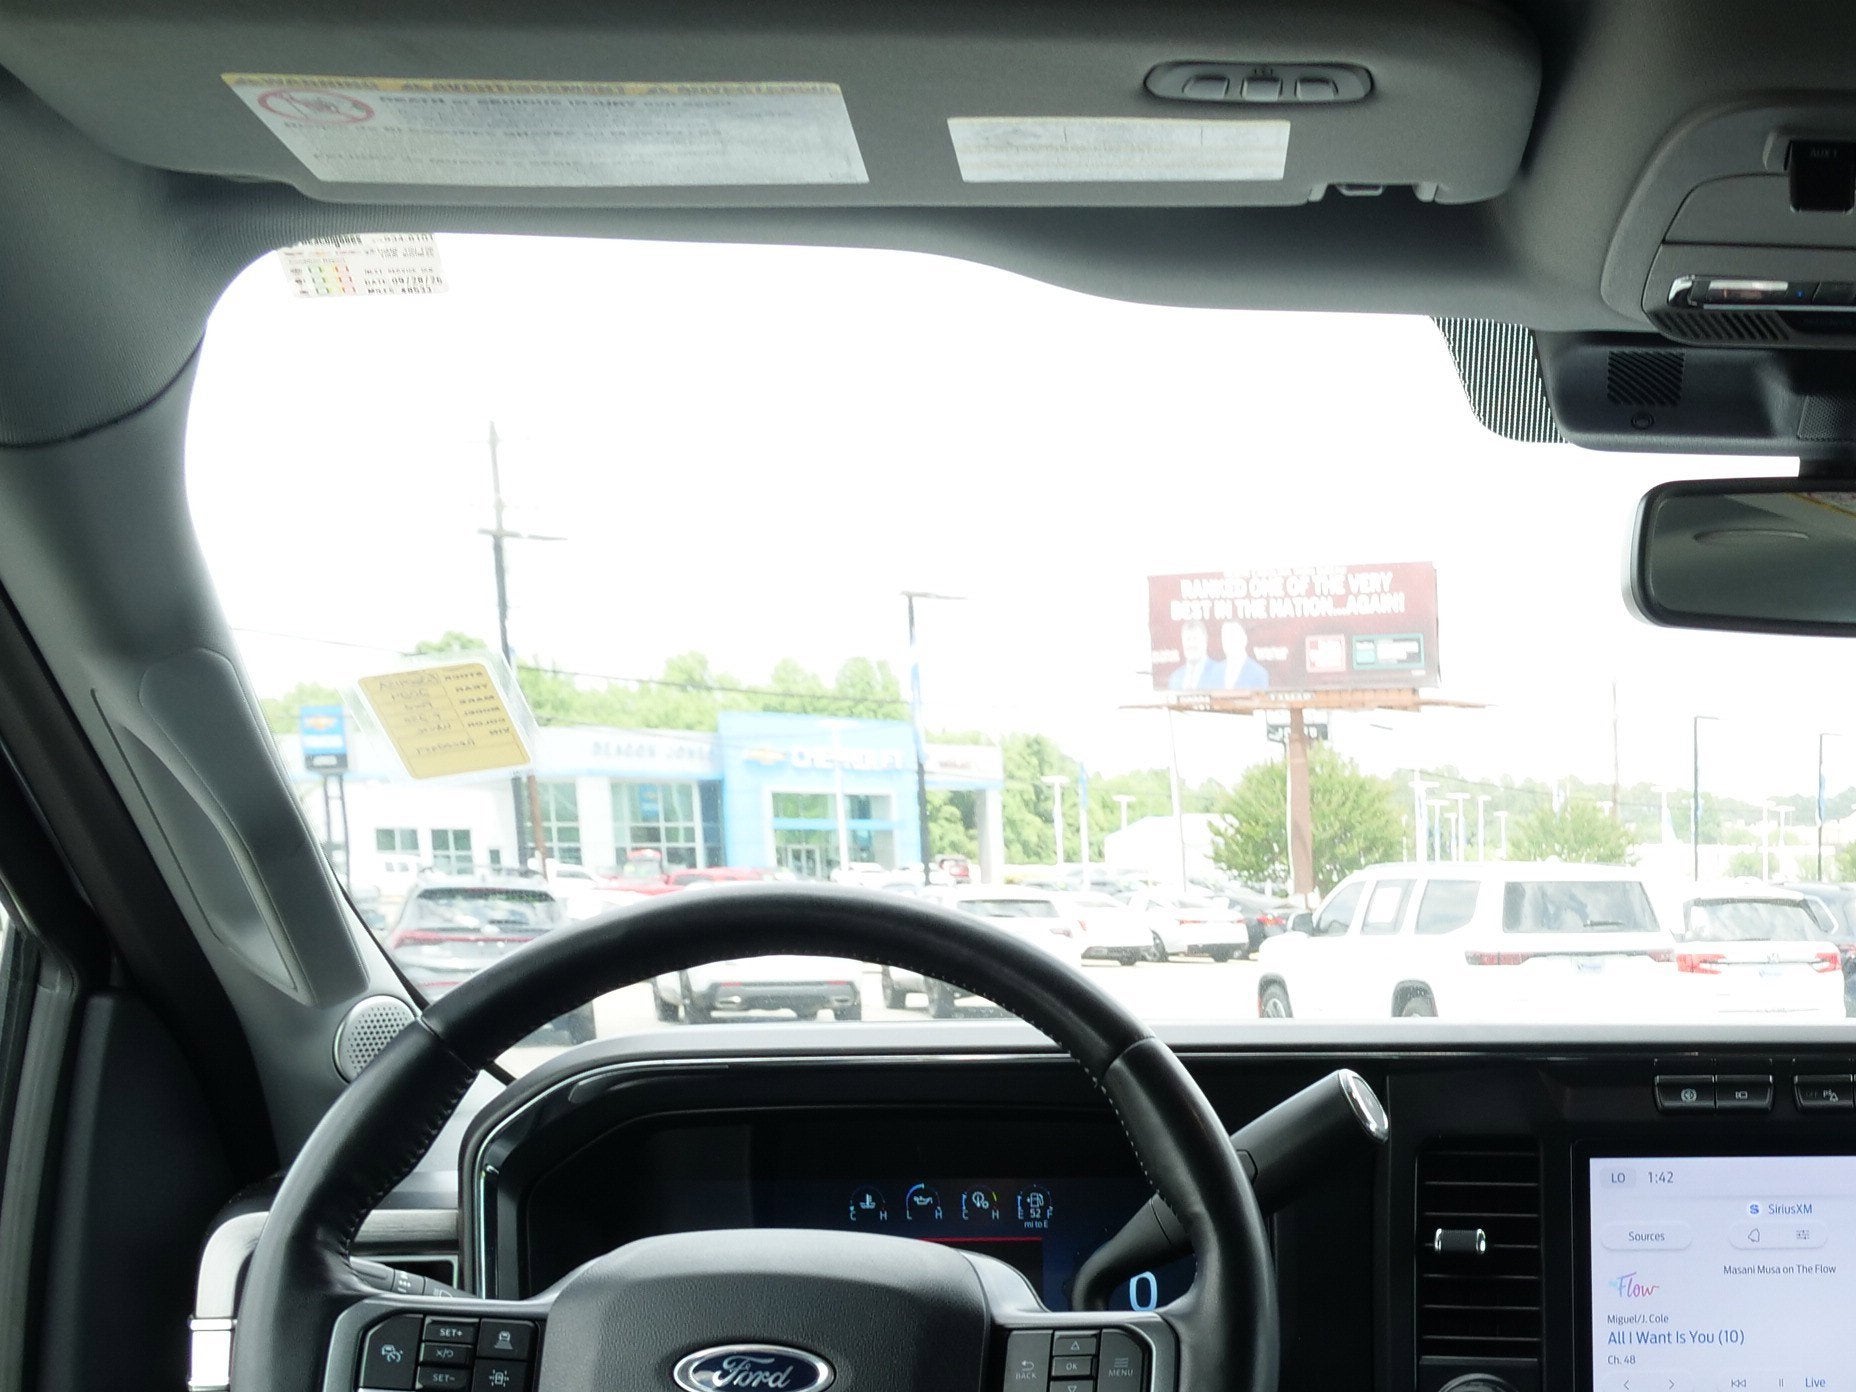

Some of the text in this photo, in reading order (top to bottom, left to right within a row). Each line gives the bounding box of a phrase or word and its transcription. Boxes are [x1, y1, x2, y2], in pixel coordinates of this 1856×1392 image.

[1180, 571, 1394, 599] RANKED ONE OF THE VERY
[1170, 599, 1212, 620] BEST
[1214, 599, 1233, 619] IN
[1235, 598, 1268, 619] THE
[1611, 1172, 1626, 1184] LO
[1648, 1171, 1674, 1184] 1:42
[1029, 1208, 1041, 1219] 52
[1768, 1203, 1813, 1215] SiriusXM
[1628, 1231, 1666, 1242] Sources
[1757, 1265, 1781, 1275] Musa
[1783, 1267, 1794, 1275] on
[1795, 1264, 1813, 1275] The
[1814, 1264, 1837, 1275] Flow
[1129, 1271, 1157, 1312] 0
[1649, 1313, 1669, 1324] Cole
[1607, 1331, 1626, 1345] All
[1636, 1330, 1673, 1345] Want
[1676, 1331, 1687, 1345] Is
[1689, 1330, 1715, 1344] You
[1718, 1328, 1746, 1346] (10)
[1623, 1354, 1636, 1365] 48
[711, 1355, 794, 1389] Ford
[1066, 1363, 1078, 1371] OK
[1108, 1369, 1134, 1377] MENU
[1805, 1377, 1826, 1388] Live
